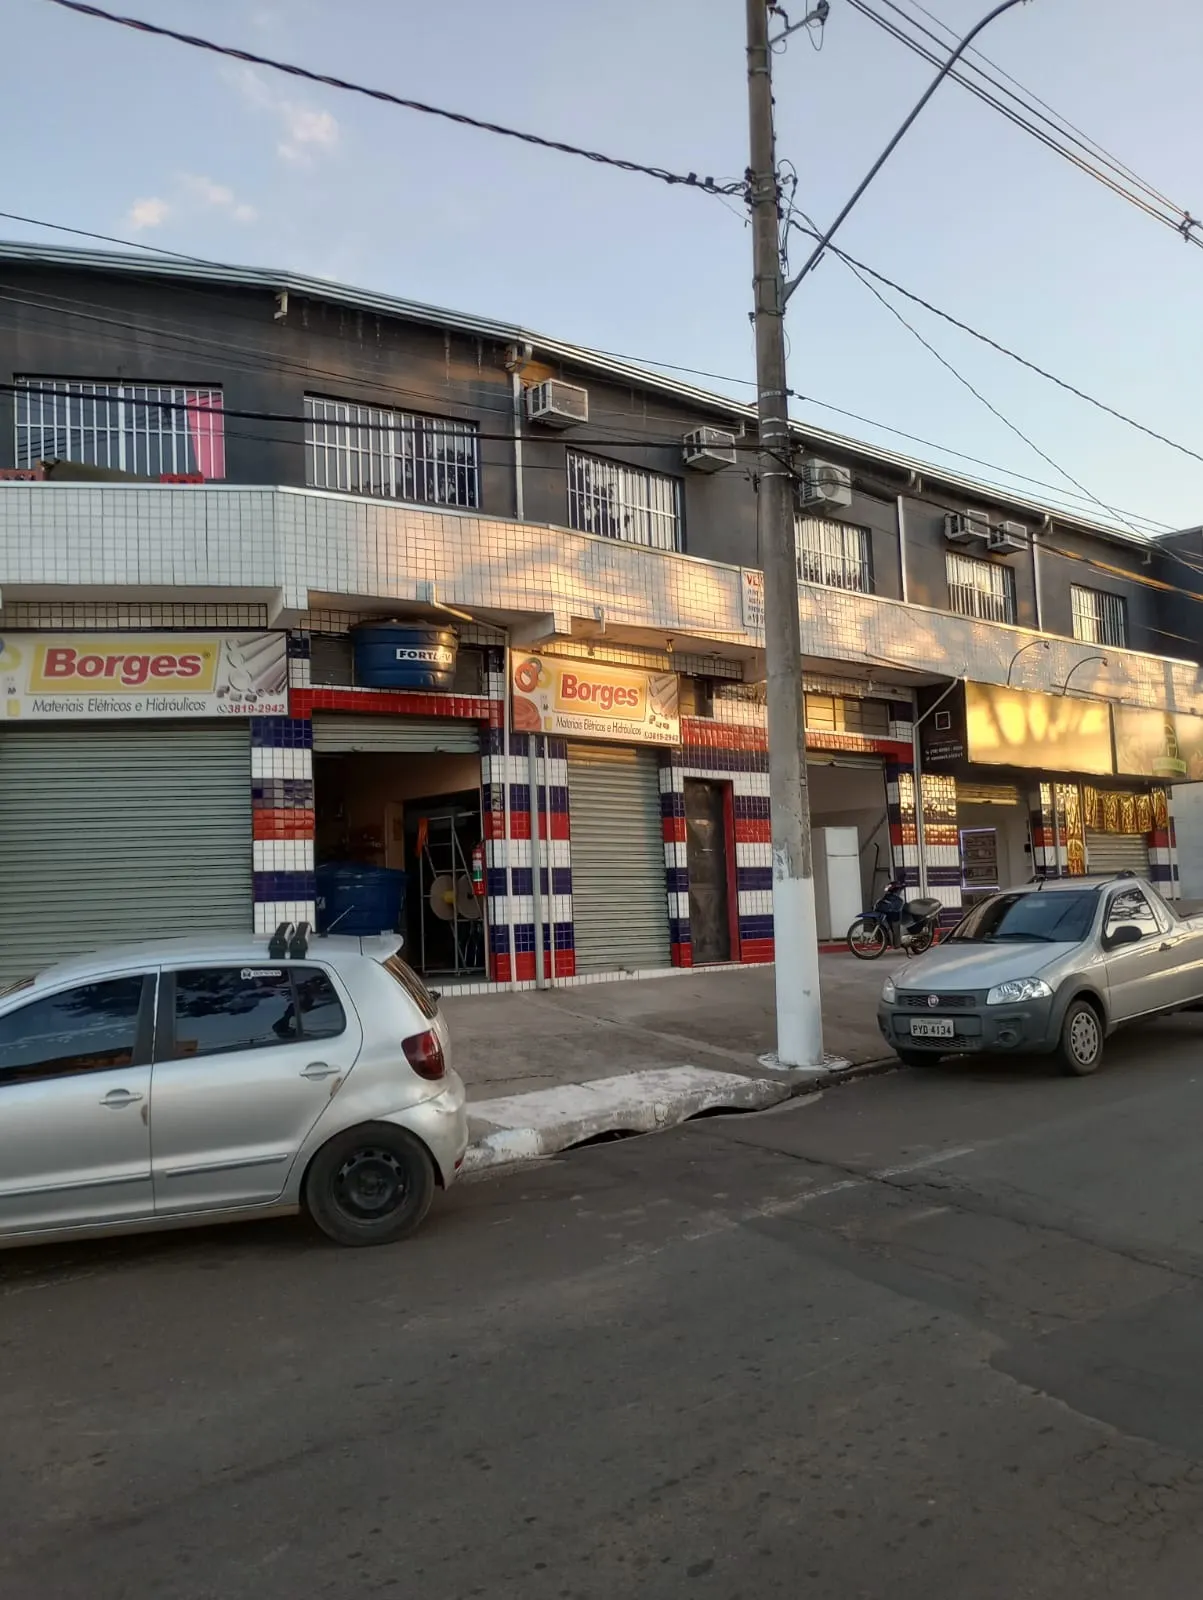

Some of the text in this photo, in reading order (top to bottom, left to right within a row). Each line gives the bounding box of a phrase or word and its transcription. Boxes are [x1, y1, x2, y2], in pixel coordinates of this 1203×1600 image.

[44, 648, 202, 686] Borges
[561, 673, 639, 710] Borges
[32, 697, 206, 712] Materiais Elétricos e Hidráulicos
[228, 703, 285, 713] 3819-2942
[556, 716, 583, 730] Materiais
[606, 724, 612, 733] e
